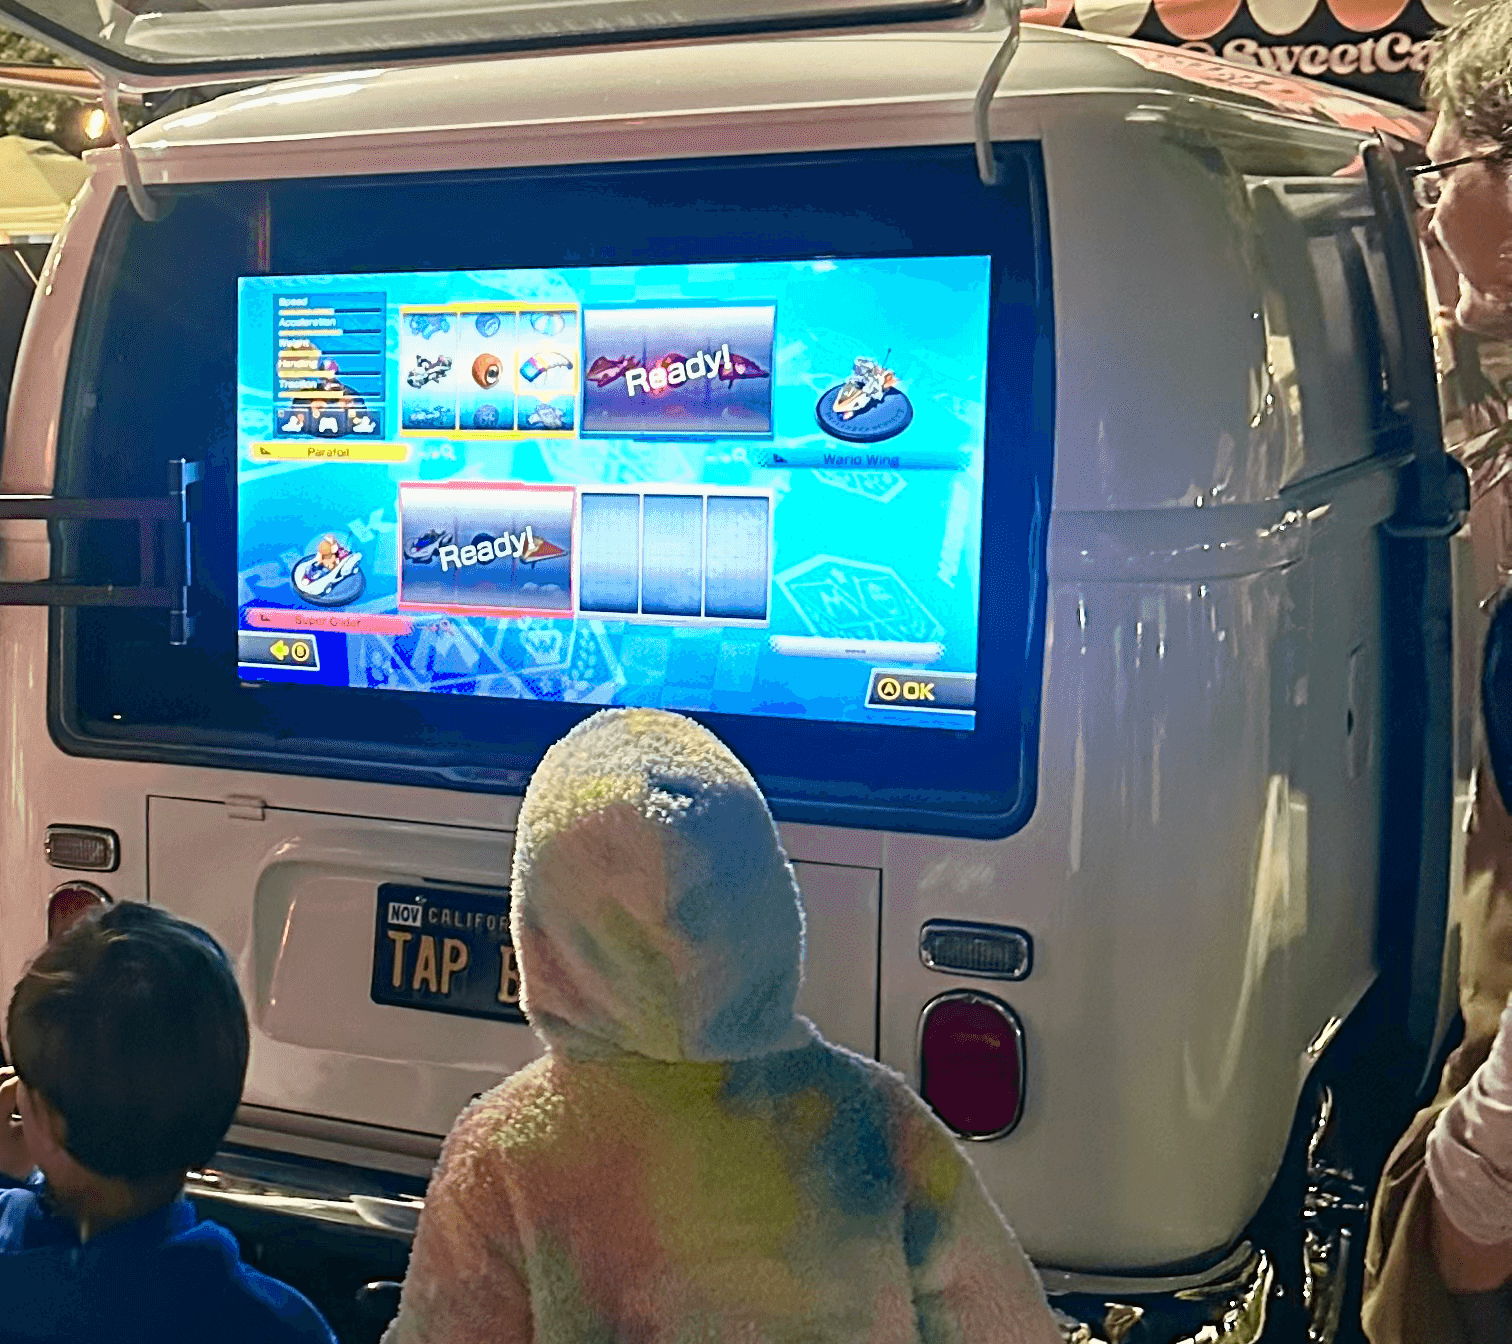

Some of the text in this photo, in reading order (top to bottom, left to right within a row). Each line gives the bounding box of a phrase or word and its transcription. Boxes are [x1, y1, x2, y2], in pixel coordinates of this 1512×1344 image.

[1180, 32, 1431, 74] SweetCa
[625, 343, 733, 397] Ready!
[823, 453, 900, 469] Wario Wing
[438, 525, 537, 572] Ready!
[902, 681, 936, 701] OK
[390, 904, 421, 924] NOV
[428, 907, 509, 931] CALIFOR
[388, 930, 522, 1004] TAP B
